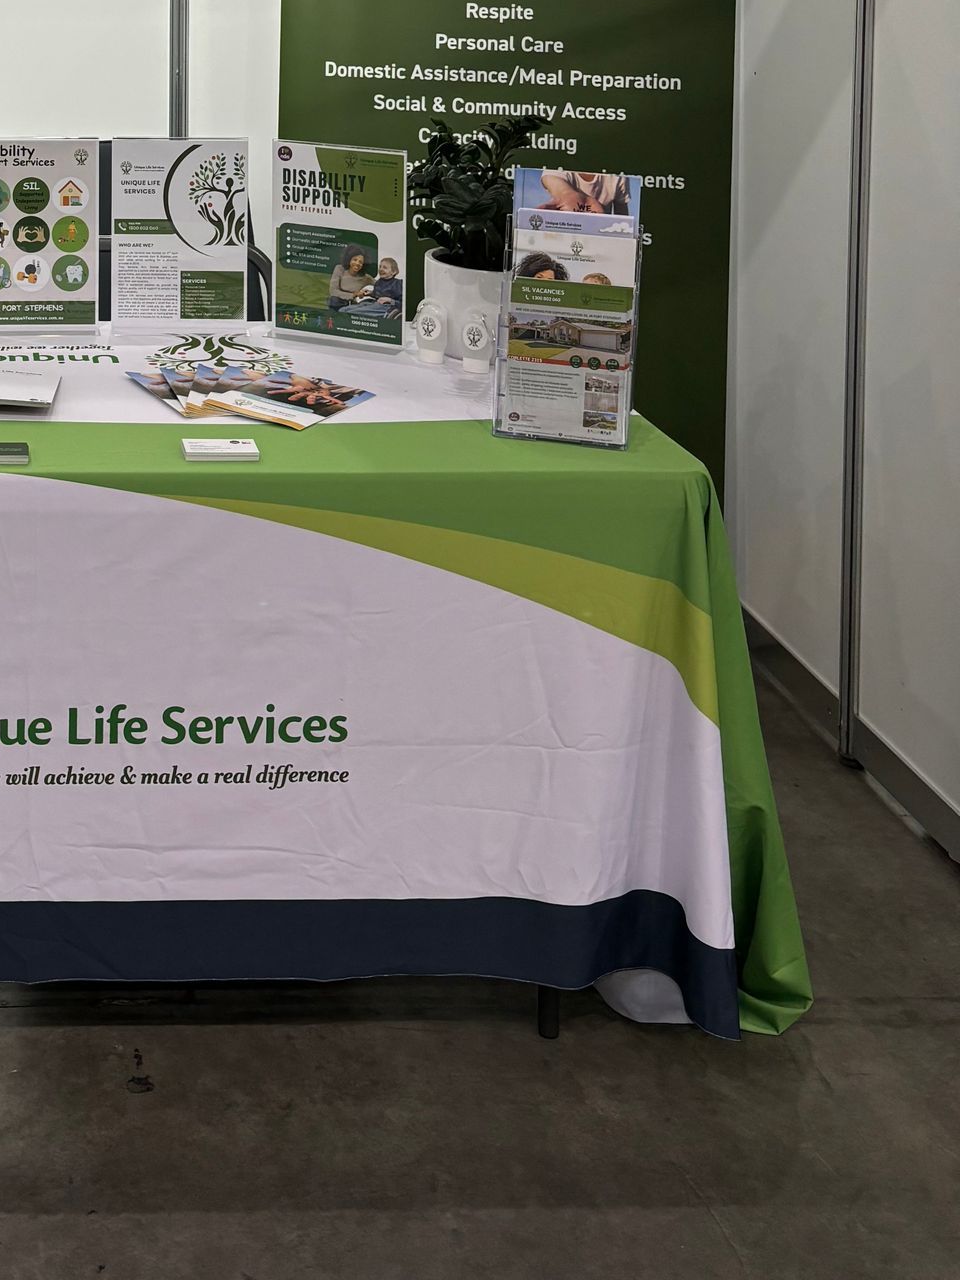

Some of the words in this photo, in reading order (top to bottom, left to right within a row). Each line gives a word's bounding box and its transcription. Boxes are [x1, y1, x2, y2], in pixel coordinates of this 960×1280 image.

[466, 2, 534, 23] Respite
[435, 33, 515, 52] Personal
[521, 36, 564, 53] Care
[325, 61, 406, 80] Domestic
[410, 64, 564, 86] Assistance/Meal
[570, 70, 682, 91] Preparation
[373, 94, 427, 112] Social
[432, 96, 447, 113] &
[452, 97, 557, 120] Community
[561, 102, 627, 121] Access
[418, 127, 495, 149] Cacity
[12, 157, 55, 167] Services
[22, 181, 41, 190] SIL
[283, 168, 366, 192] DISABILITY
[282, 185, 350, 209] SUPPORT
[577, 202, 592, 212] WE
[300, 206, 332, 215] STEPHENS
[532, 287, 565, 295] VACANCIES
[68, 703, 148, 745] Life
[160, 703, 348, 745] Services
[5, 766, 41, 786] will
[43, 766, 115, 785] achieve
[120, 765, 136, 785] &
[140, 764, 192, 785] make
[197, 771, 209, 784] a
[214, 764, 252, 784] real
[255, 763, 350, 790] difference
